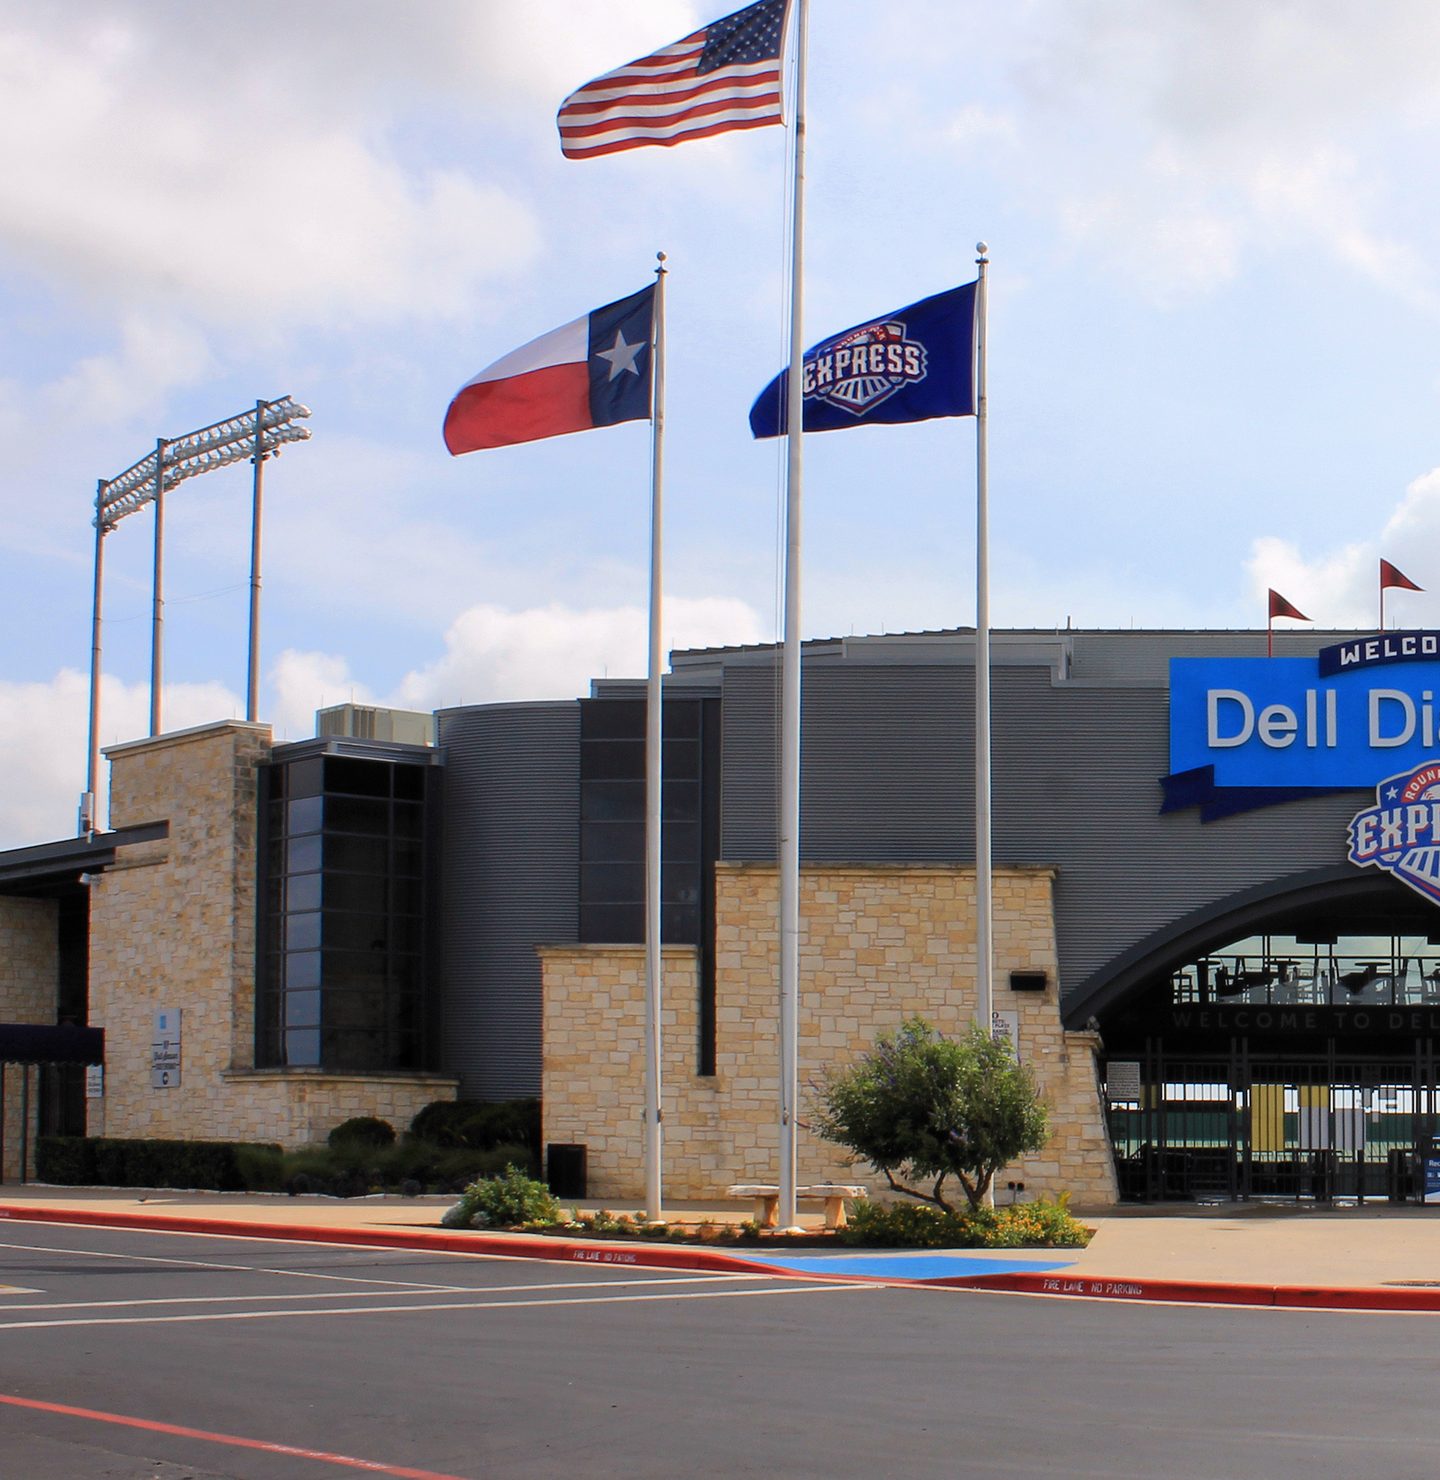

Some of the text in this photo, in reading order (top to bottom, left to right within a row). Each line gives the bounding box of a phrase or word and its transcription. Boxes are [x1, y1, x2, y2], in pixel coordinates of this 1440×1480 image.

[803, 344, 921, 394] EXPRESS
[1206, 689, 1337, 748] Dell
[1172, 1012, 1317, 1029] WELCOME
[1333, 1012, 1370, 1029] TO
[1043, 1279, 1143, 1295] FIRE LANE NO PARKING
